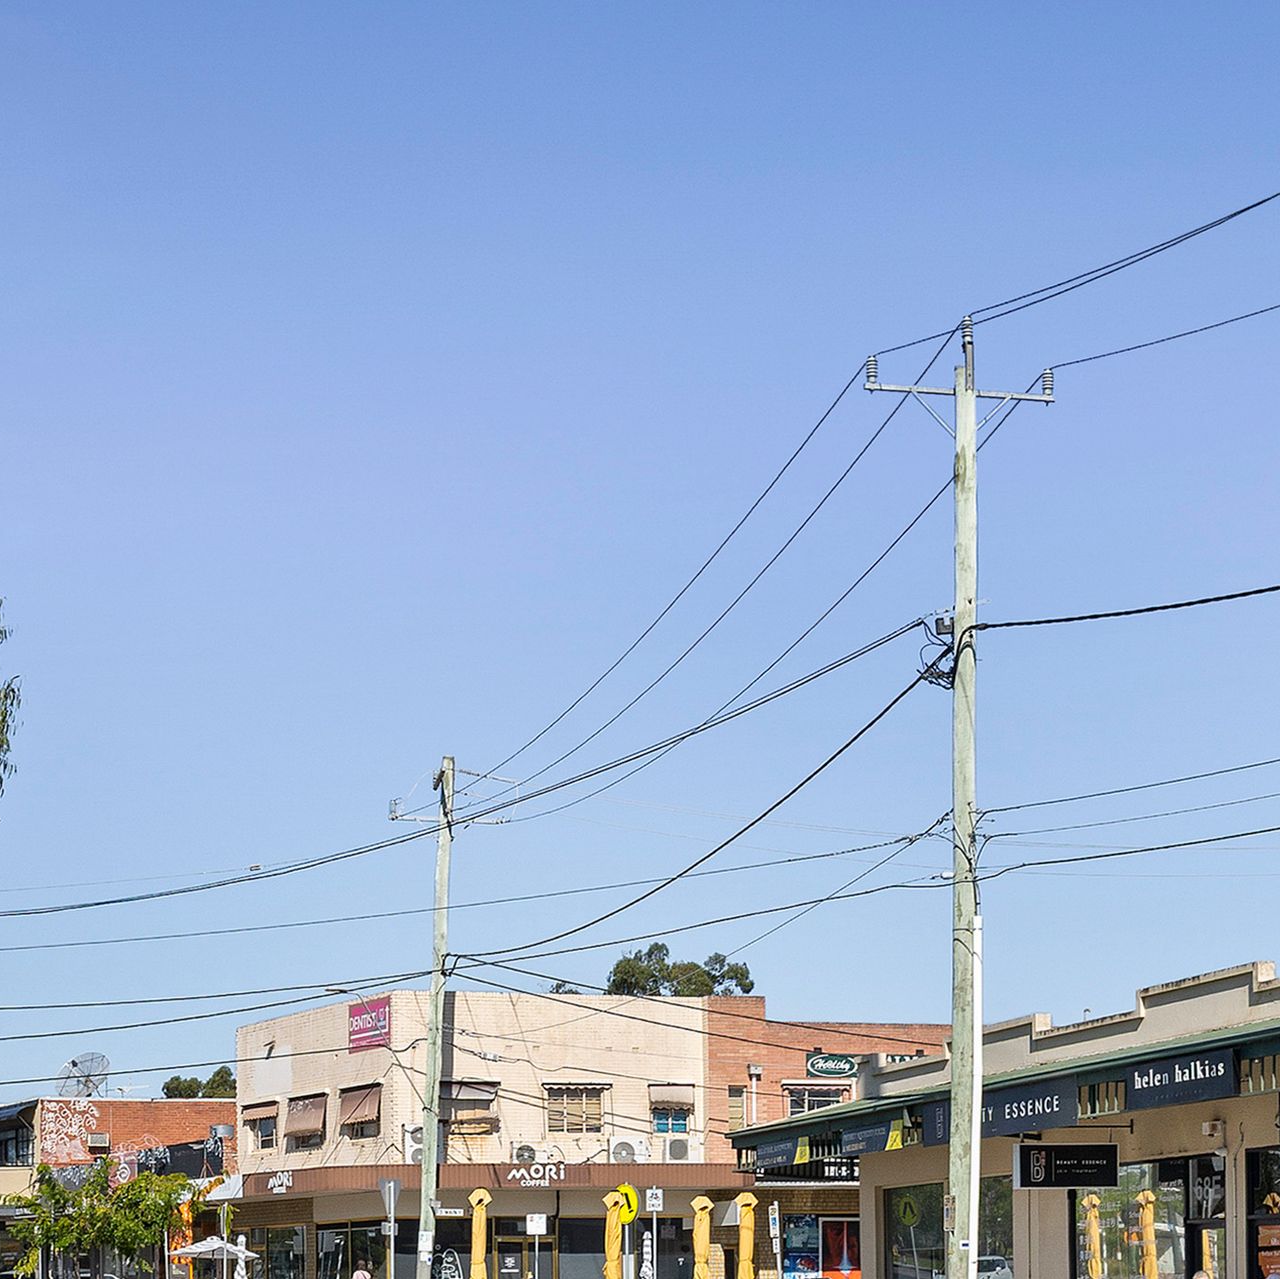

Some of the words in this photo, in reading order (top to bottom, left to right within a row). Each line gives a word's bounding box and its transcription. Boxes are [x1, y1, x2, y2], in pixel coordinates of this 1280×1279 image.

[1134, 1068, 1169, 1090] helen
[1174, 1060, 1225, 1083] halkias
[1004, 1095, 1060, 1118] ESSENCE
[520, 1178, 550, 1187] COFFEE
